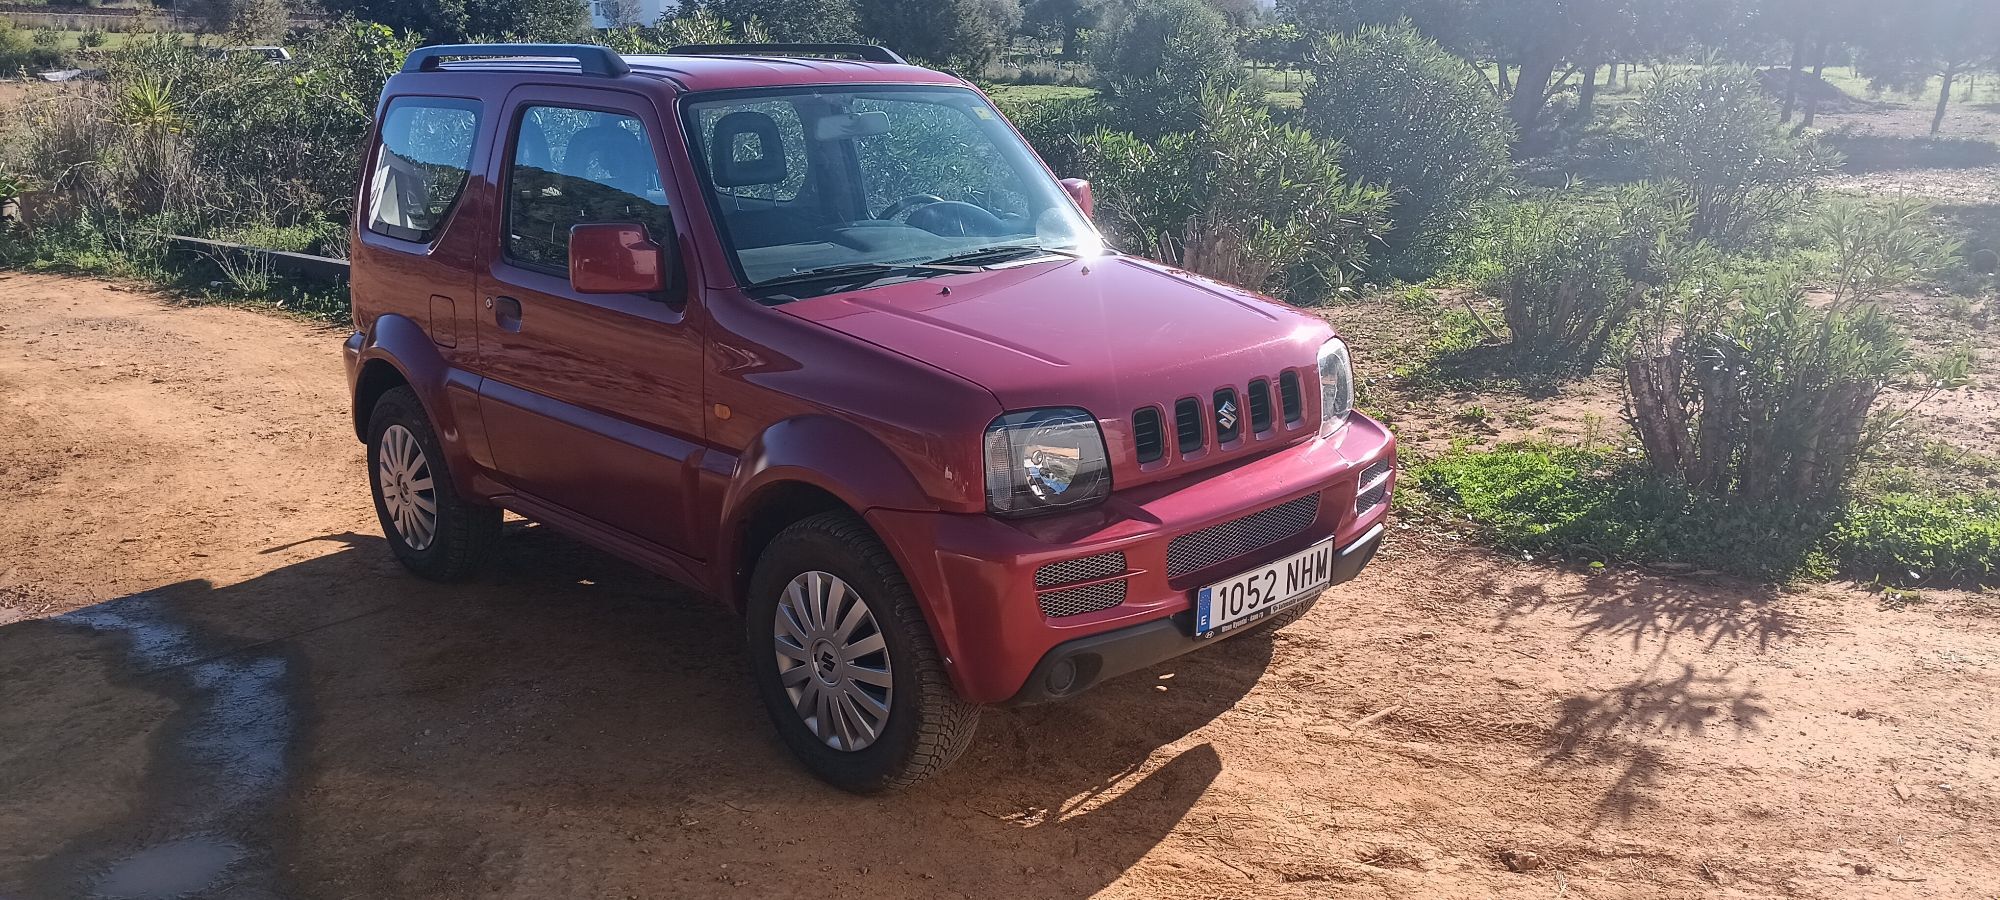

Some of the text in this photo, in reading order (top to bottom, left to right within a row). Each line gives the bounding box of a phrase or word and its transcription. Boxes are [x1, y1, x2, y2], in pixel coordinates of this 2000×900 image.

[1219, 547, 1328, 621] 1052 NHM
[1200, 614, 1207, 626] E
